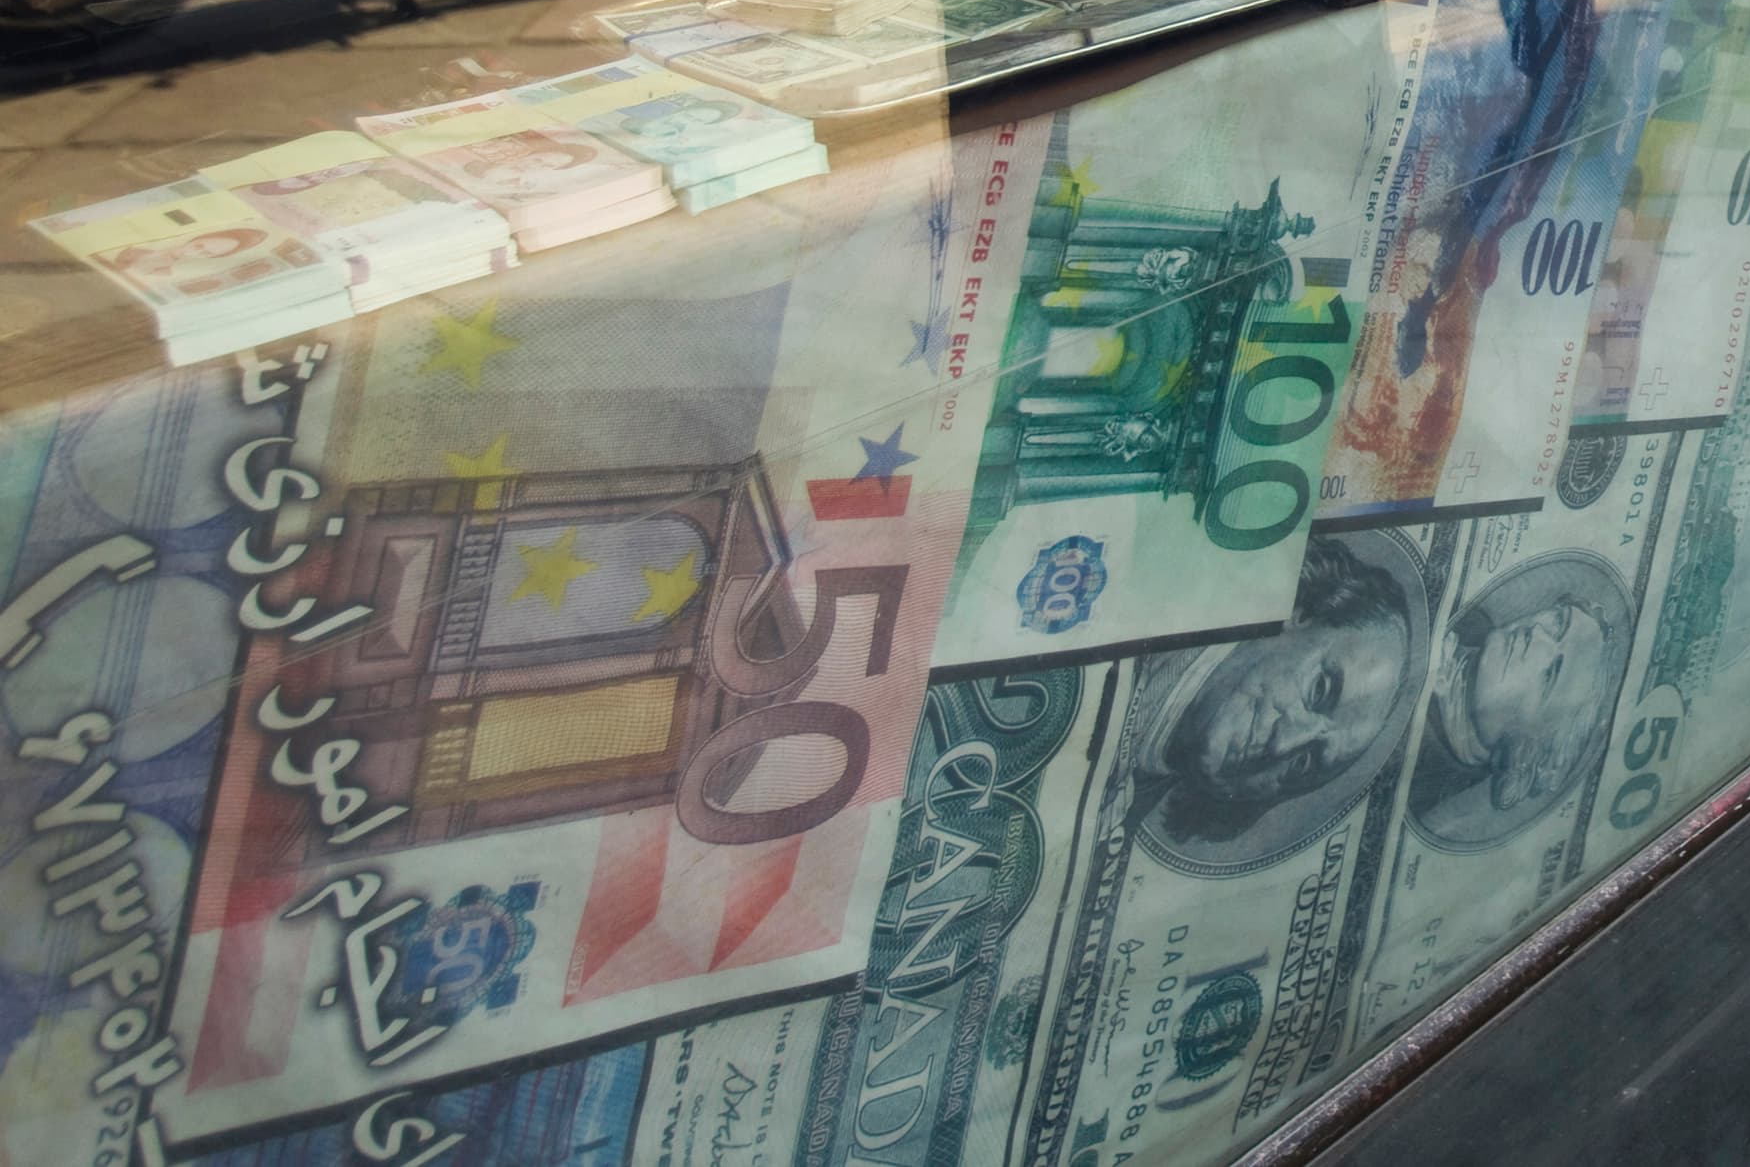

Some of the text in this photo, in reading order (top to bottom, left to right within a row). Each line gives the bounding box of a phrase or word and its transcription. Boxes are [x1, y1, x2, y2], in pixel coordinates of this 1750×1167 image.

[1400, 76, 1415, 110] ECB
[1389, 118, 1403, 147] EZB
[983, 160, 1008, 206] ECB
[1366, 191, 1380, 222] EKP
[1376, 157, 1392, 190] EKT
[972, 218, 997, 265] EZB
[1368, 228, 1397, 293] Francs
[1521, 217, 1602, 297] 100
[961, 277, 983, 323] EKT
[950, 332, 971, 381] EKP
[1205, 293, 1352, 552] 100
[1319, 475, 1346, 500] 100
[223, 434, 373, 642] ارزی
[1041, 552, 1083, 623] 100
[676, 563, 911, 846] 50
[256, 683, 408, 844] امور
[1608, 715, 1678, 830] 50
[283, 870, 450, 1067] انجام
[433, 917, 490, 987] 50
[945, 972, 995, 1120] CANADA
[1044, 919, 1111, 1121] HUNDRED
[761, 1063, 782, 1116] NOTE
